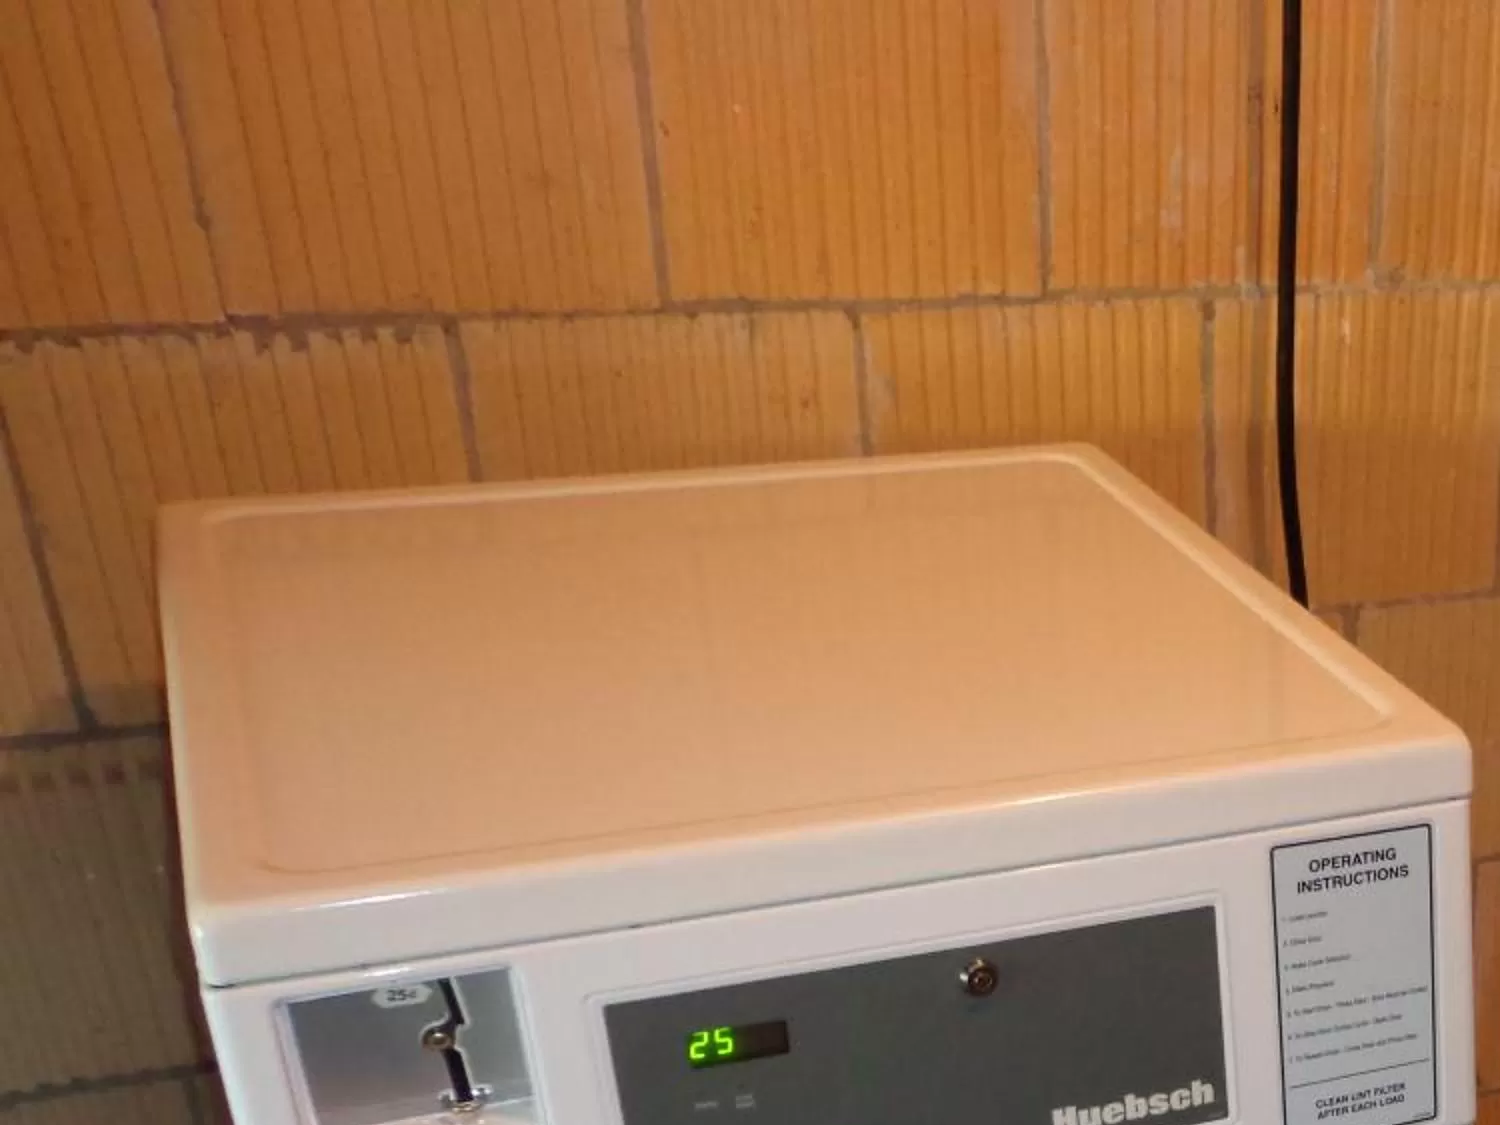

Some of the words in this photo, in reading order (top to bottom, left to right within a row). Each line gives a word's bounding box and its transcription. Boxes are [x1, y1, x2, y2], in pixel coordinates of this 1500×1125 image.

[1308, 847, 1397, 873] OPERATING
[1297, 864, 1409, 894] INSTRUCTIONS
[689, 1026, 733, 1060] 25
[1315, 1094, 1349, 1109] CLEAN
[1351, 1088, 1371, 1102] LINT
[1373, 1082, 1406, 1097] FILTER
[1317, 1106, 1349, 1120] AFTER
[1351, 1100, 1377, 1113] EACH
[1379, 1093, 1405, 1107] LOAD
